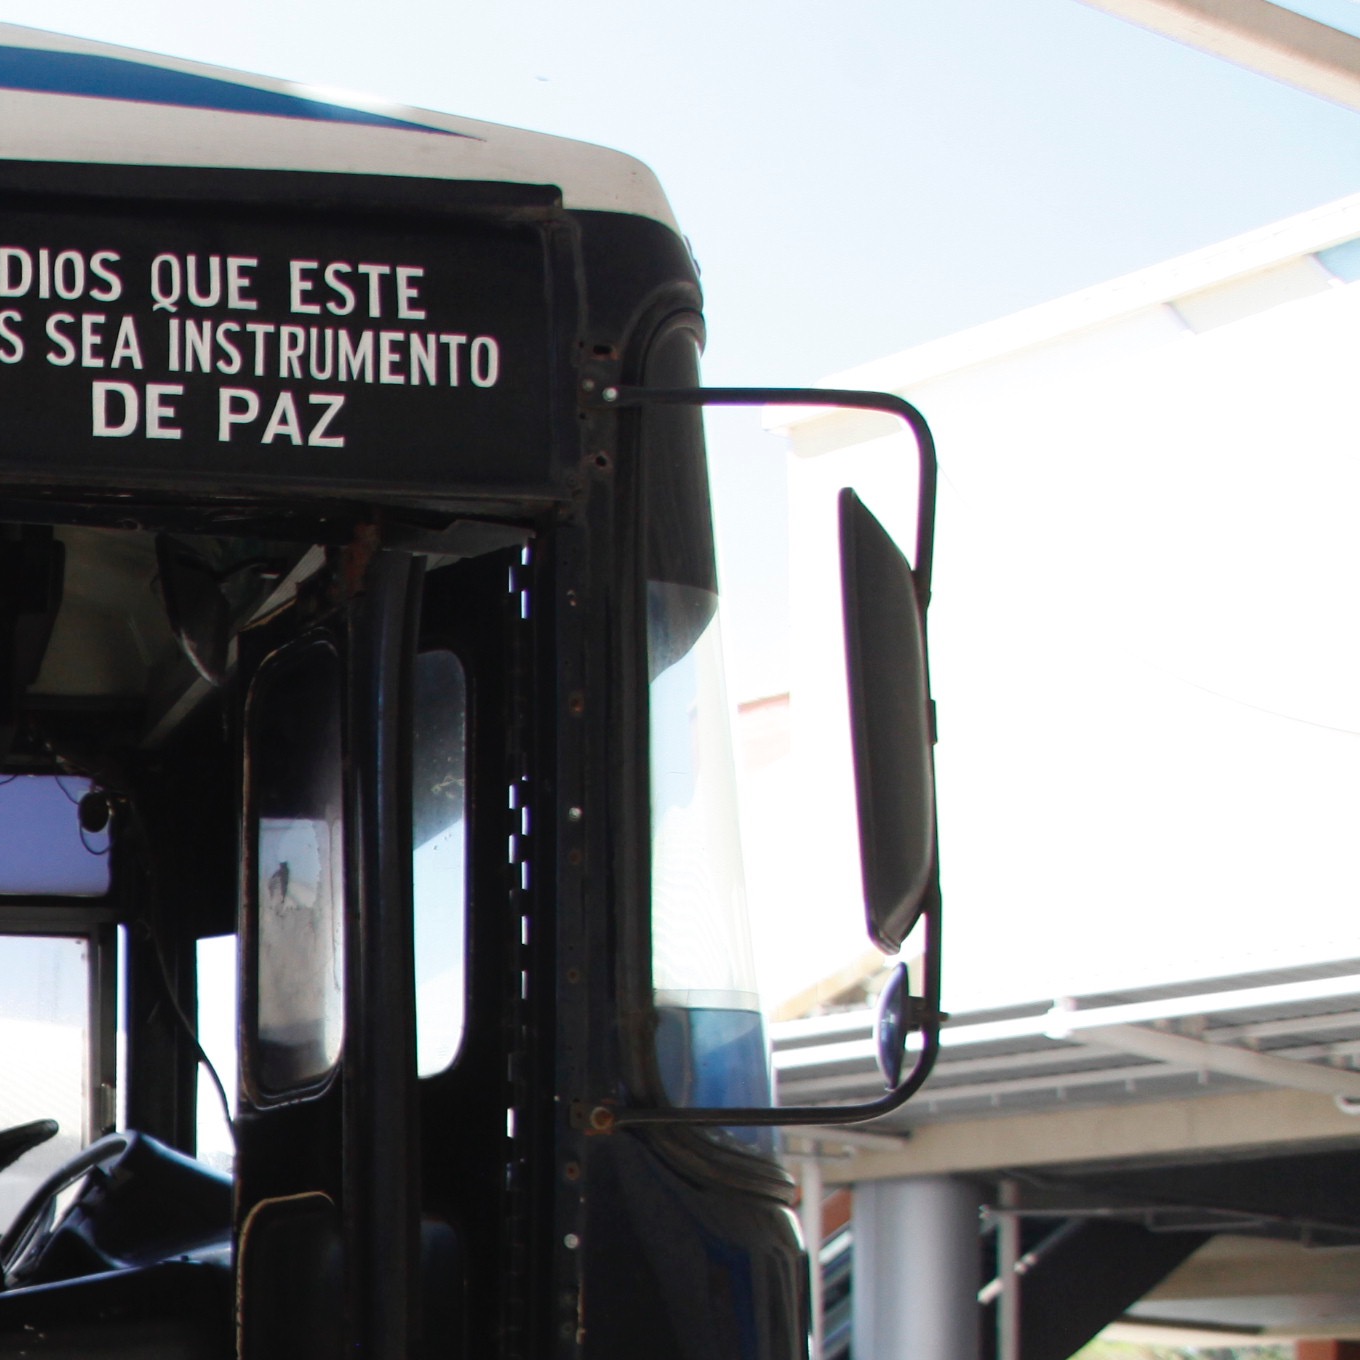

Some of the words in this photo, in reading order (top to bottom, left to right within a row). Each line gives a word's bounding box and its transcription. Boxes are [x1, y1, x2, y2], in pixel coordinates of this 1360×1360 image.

[150, 252, 258, 313] QUE
[289, 259, 426, 320] ESTE
[45, 311, 143, 370] SEA
[168, 317, 499, 388] INSTRUMENTO
[92, 379, 184, 440] DE
[218, 386, 346, 448] PAZ
